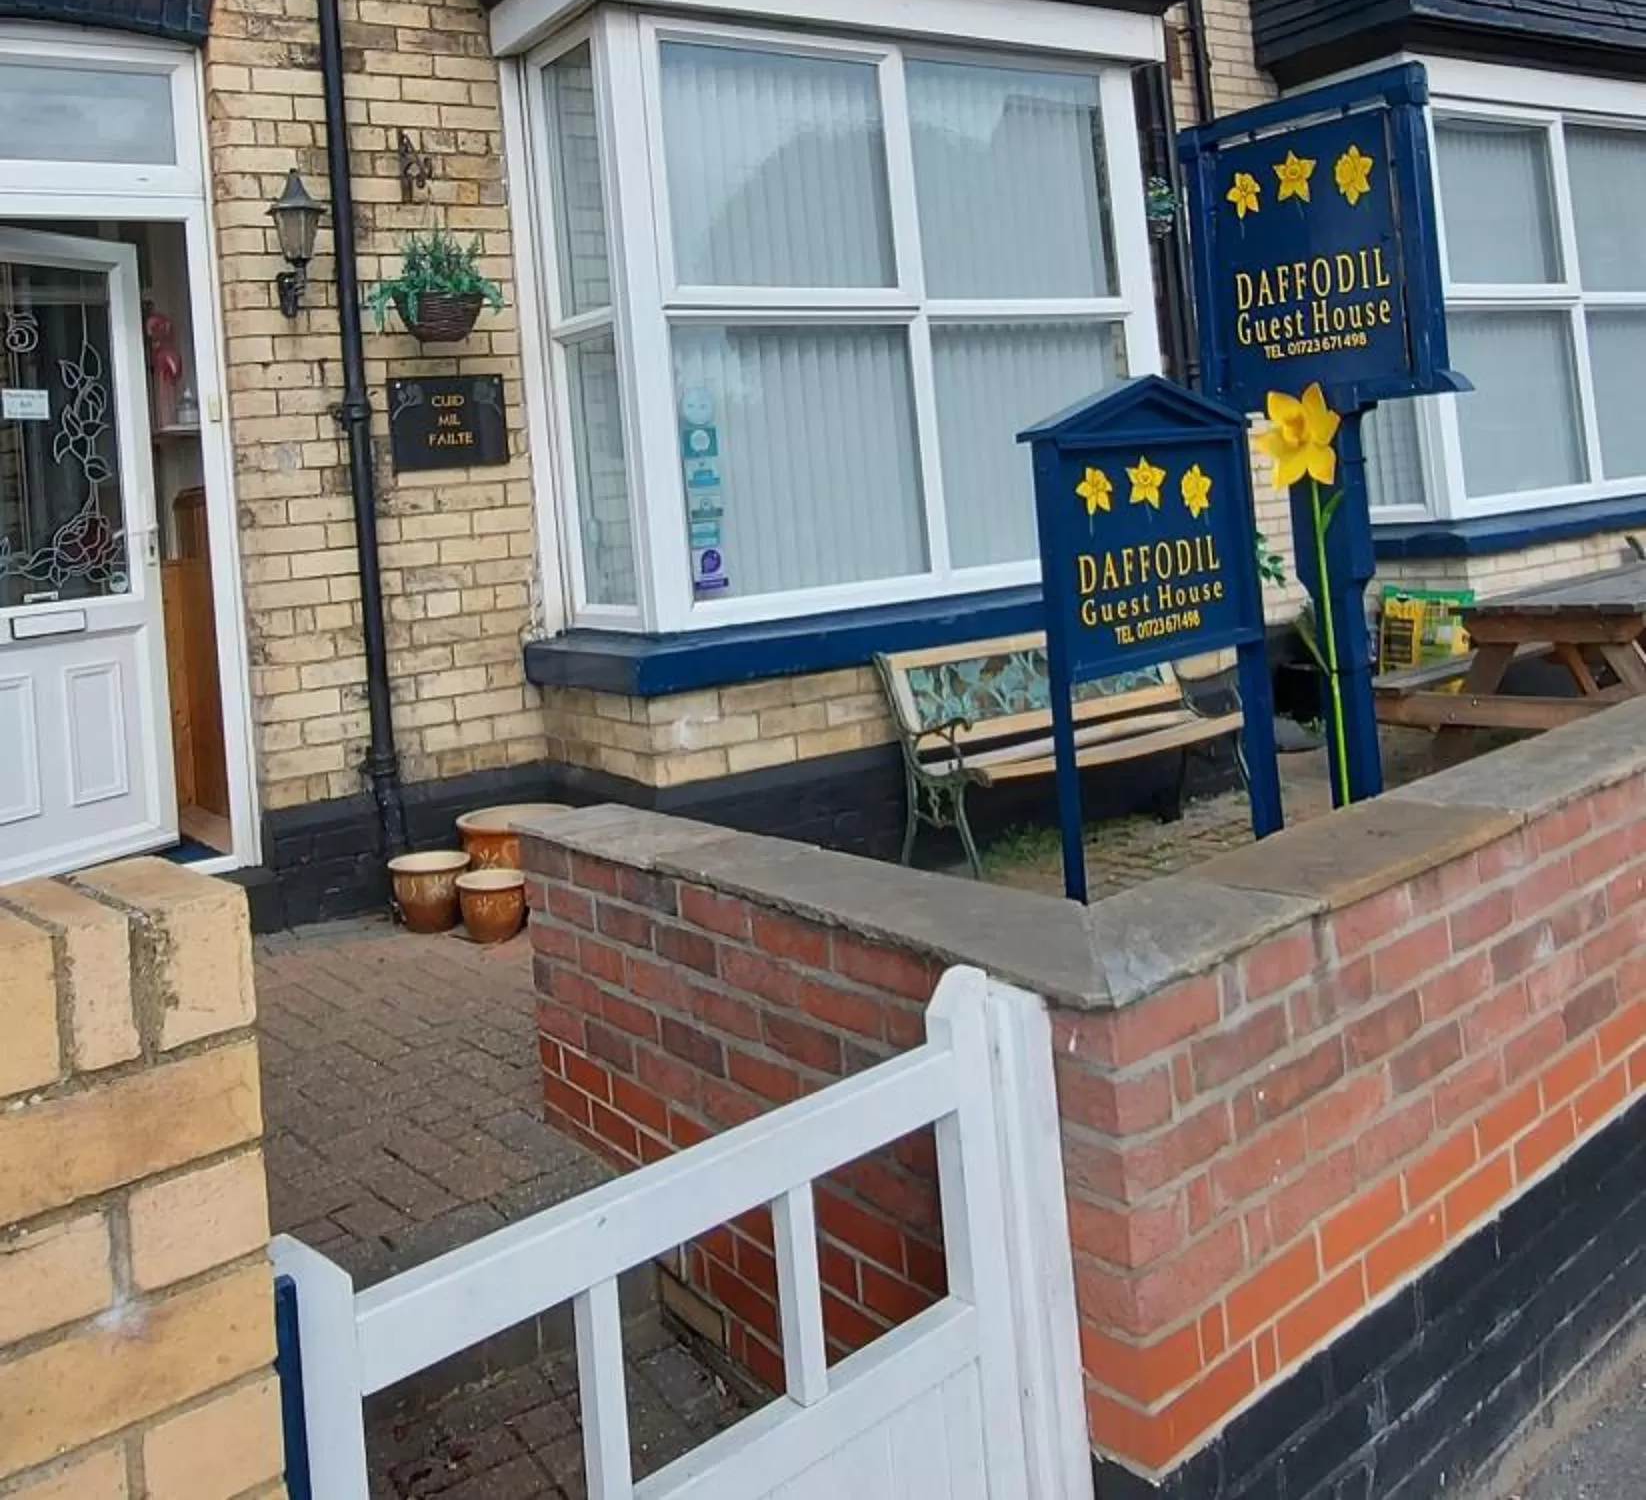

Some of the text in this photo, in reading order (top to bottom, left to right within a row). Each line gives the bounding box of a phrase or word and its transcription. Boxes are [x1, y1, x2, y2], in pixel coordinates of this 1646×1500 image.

[1235, 248, 1390, 310] DAFFODIL
[1237, 299, 1391, 345] Guest House
[1077, 535, 1220, 595] DAFFODIL
[1081, 580, 1223, 626] Guest House
